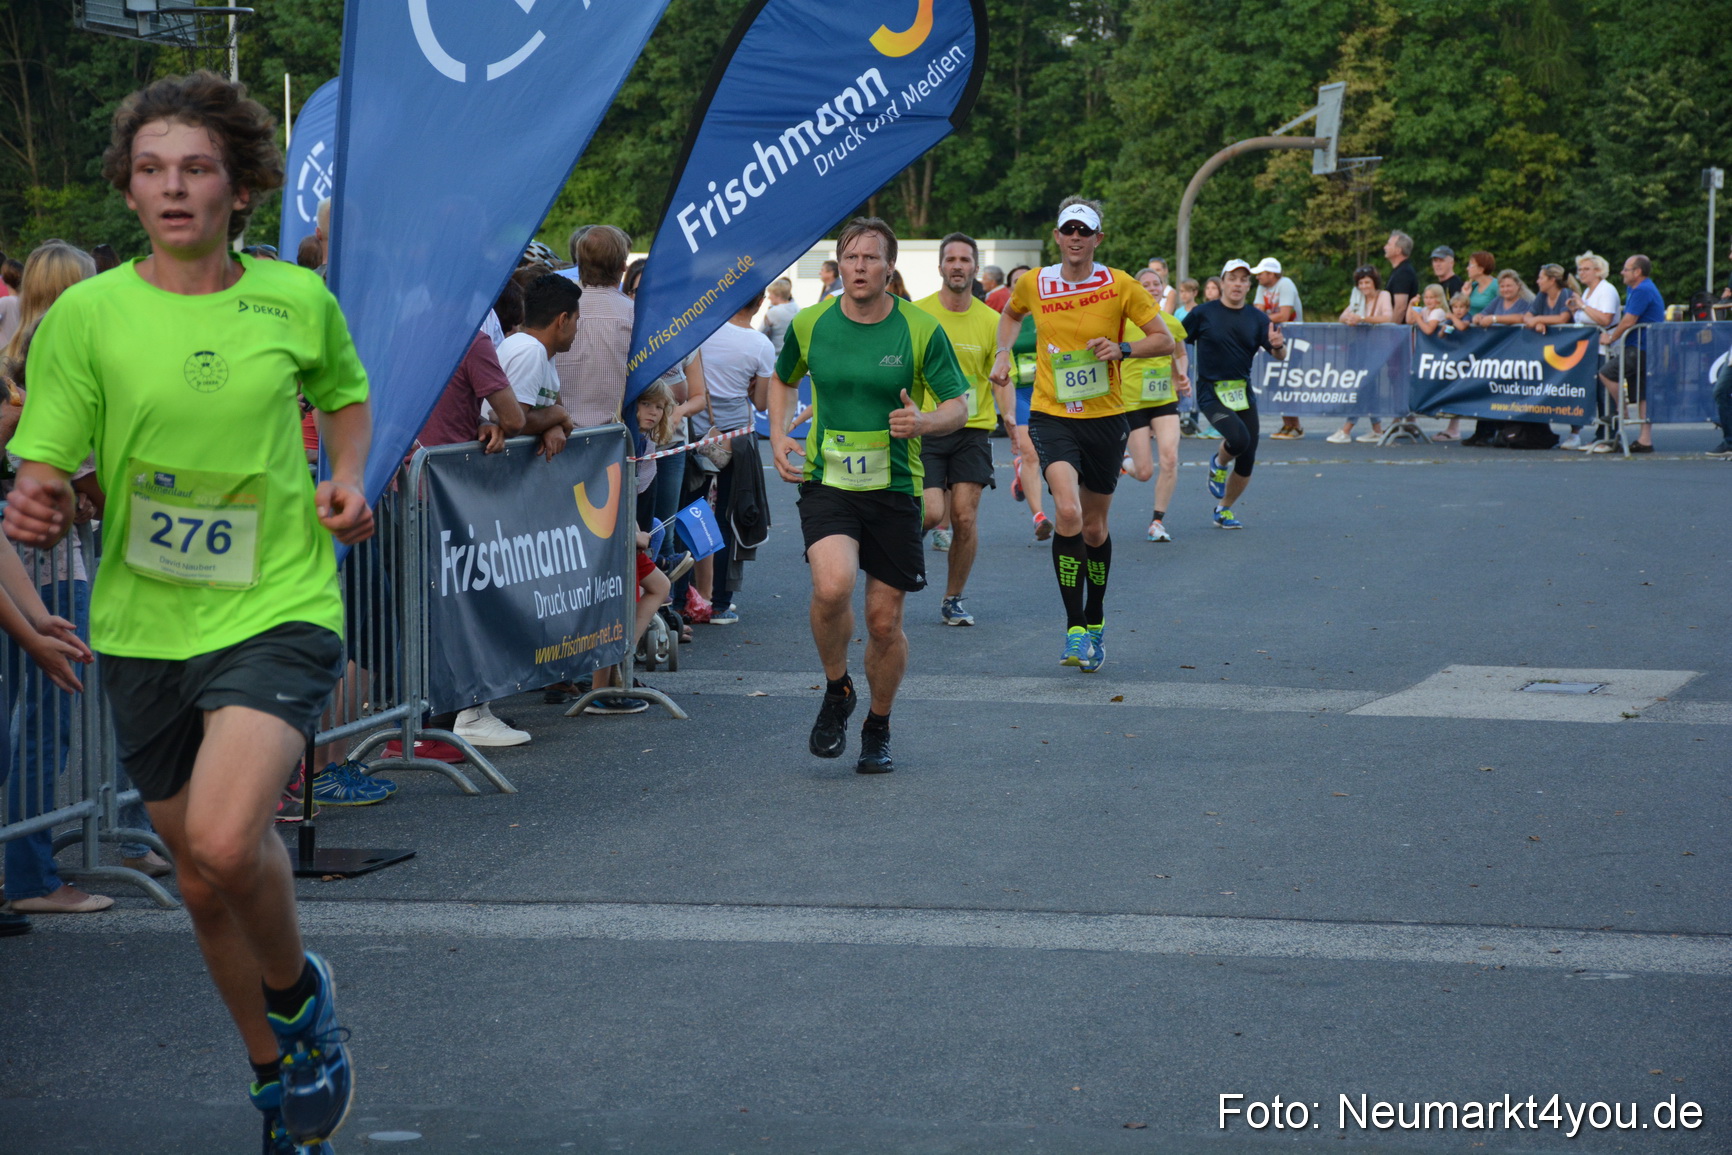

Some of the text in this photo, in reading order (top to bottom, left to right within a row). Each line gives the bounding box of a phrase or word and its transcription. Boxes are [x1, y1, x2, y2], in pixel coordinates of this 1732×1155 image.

[813, 45, 966, 176] Druck und Medien
[676, 67, 889, 254] Frischmann
[253, 304, 289, 319] DEKRA
[1041, 289, 1118, 314] MAX BÖGL
[627, 255, 755, 376] ww.frischmann-net.de
[879, 355, 903, 366] AOK
[1418, 353, 1543, 381] Frischmann
[1065, 367, 1097, 388] 861
[1149, 380, 1168, 392] 616
[1263, 362, 1368, 388] Fischer
[1272, 391, 1358, 403] AUTOMOBILE
[1489, 381, 1586, 398] Druck und Medien
[842, 455, 867, 474] 11
[150, 511, 232, 555] 276
[160, 556, 181, 569] David
[440, 520, 587, 597] Frischmann
[534, 583, 568, 619] Druck
[569, 577, 592, 611] und
